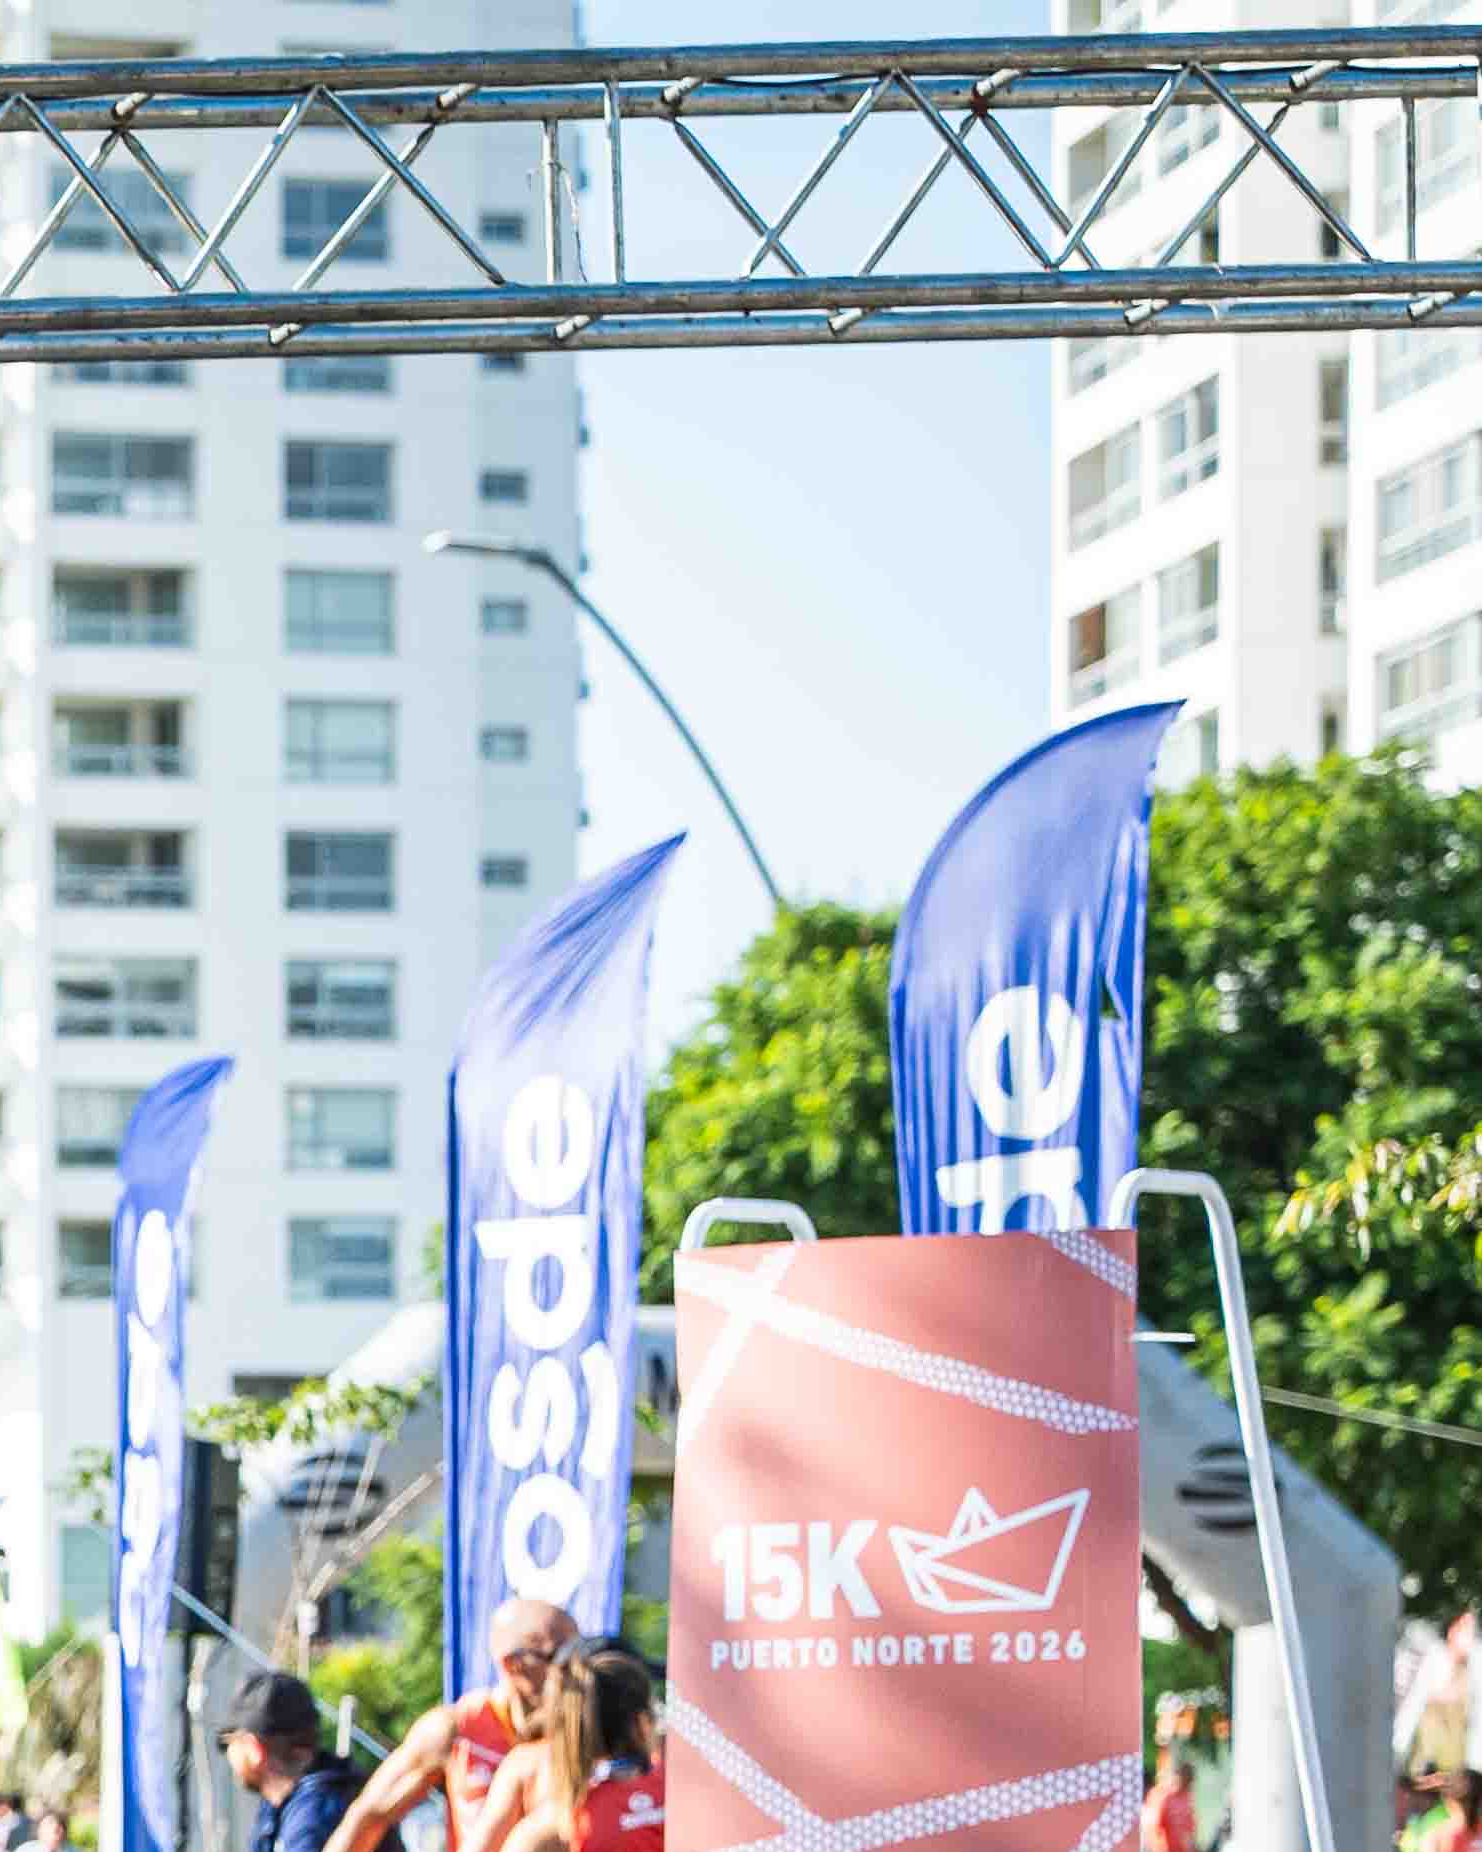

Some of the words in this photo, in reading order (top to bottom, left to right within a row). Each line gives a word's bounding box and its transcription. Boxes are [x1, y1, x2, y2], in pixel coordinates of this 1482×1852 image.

[475, 1073, 619, 1605] osde
[710, 1519, 883, 1624] 15K
[709, 1636, 838, 1671] PUERTO
[852, 1633, 974, 1665] NORTE
[990, 1630, 1087, 1662] 2026
